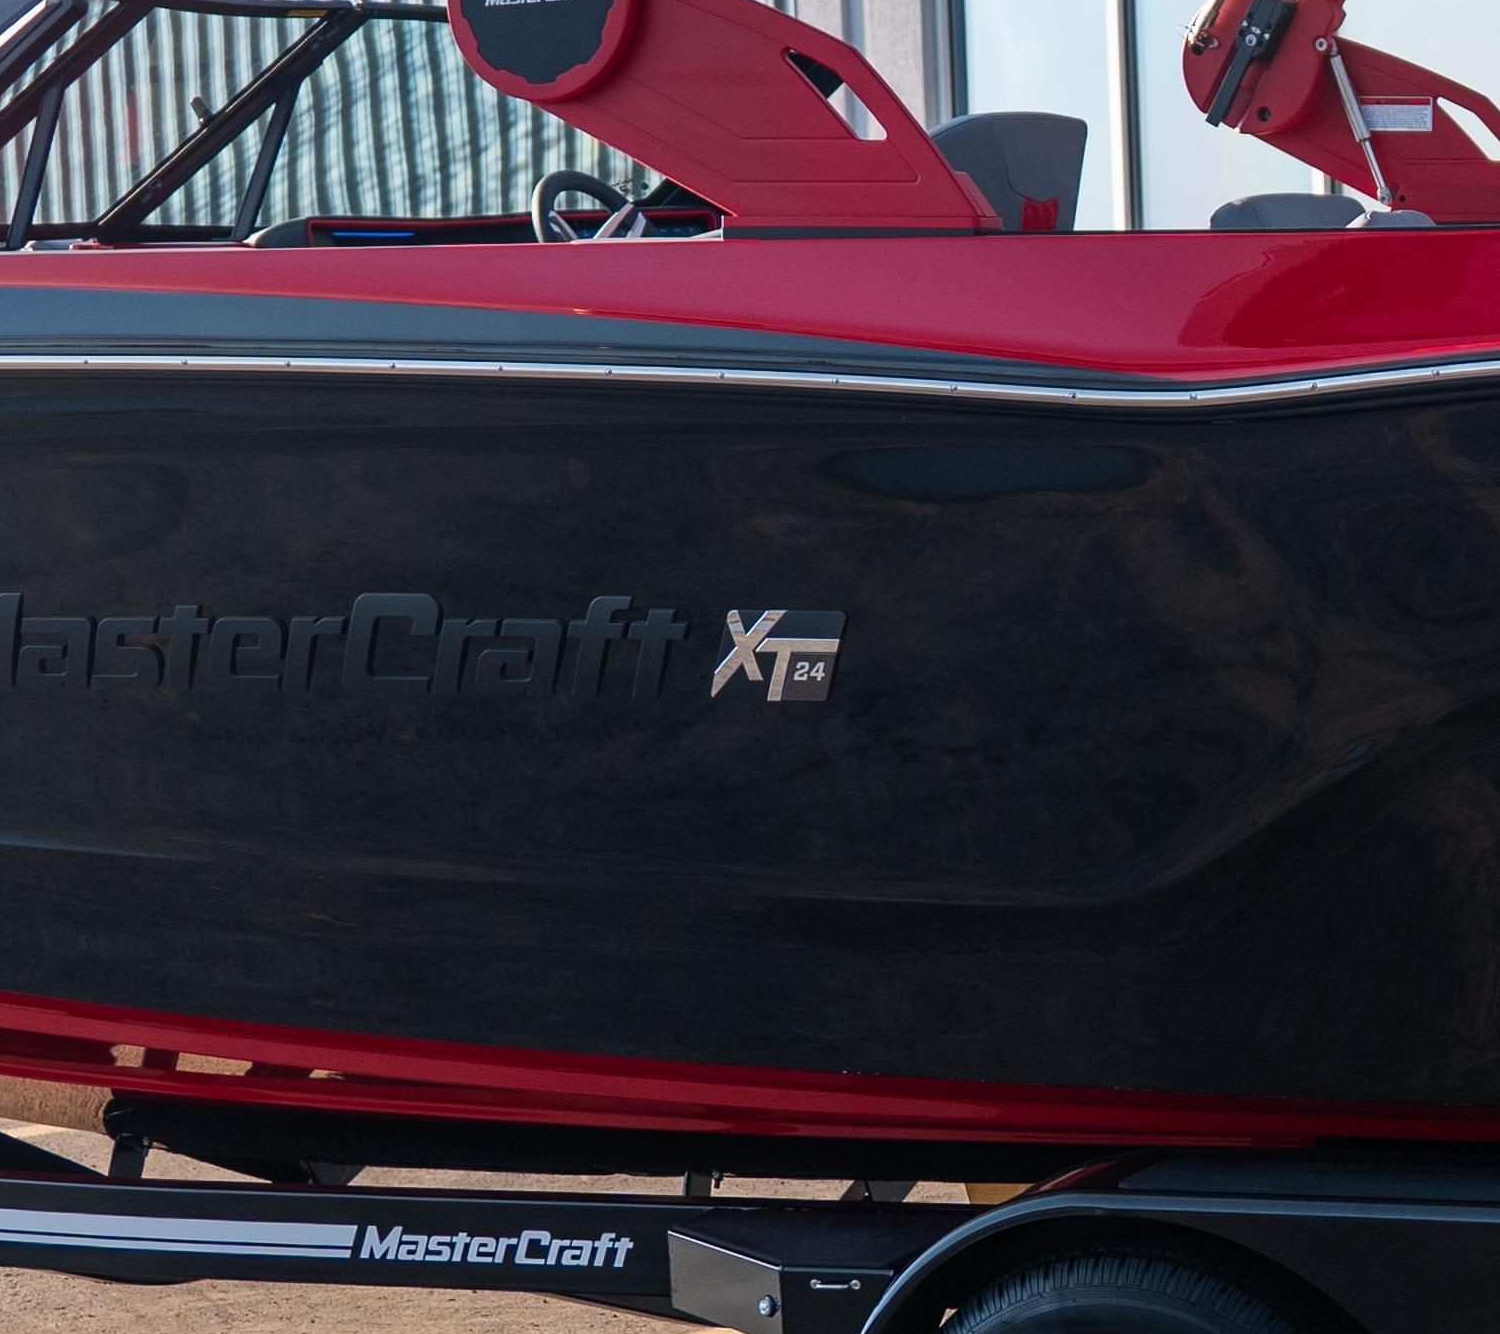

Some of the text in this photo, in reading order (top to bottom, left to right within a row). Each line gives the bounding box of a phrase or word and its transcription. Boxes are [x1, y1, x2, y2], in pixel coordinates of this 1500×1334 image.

[710, 609, 841, 702] XT
[793, 661, 826, 681] 24
[359, 1224, 634, 1268] MasterCraft
